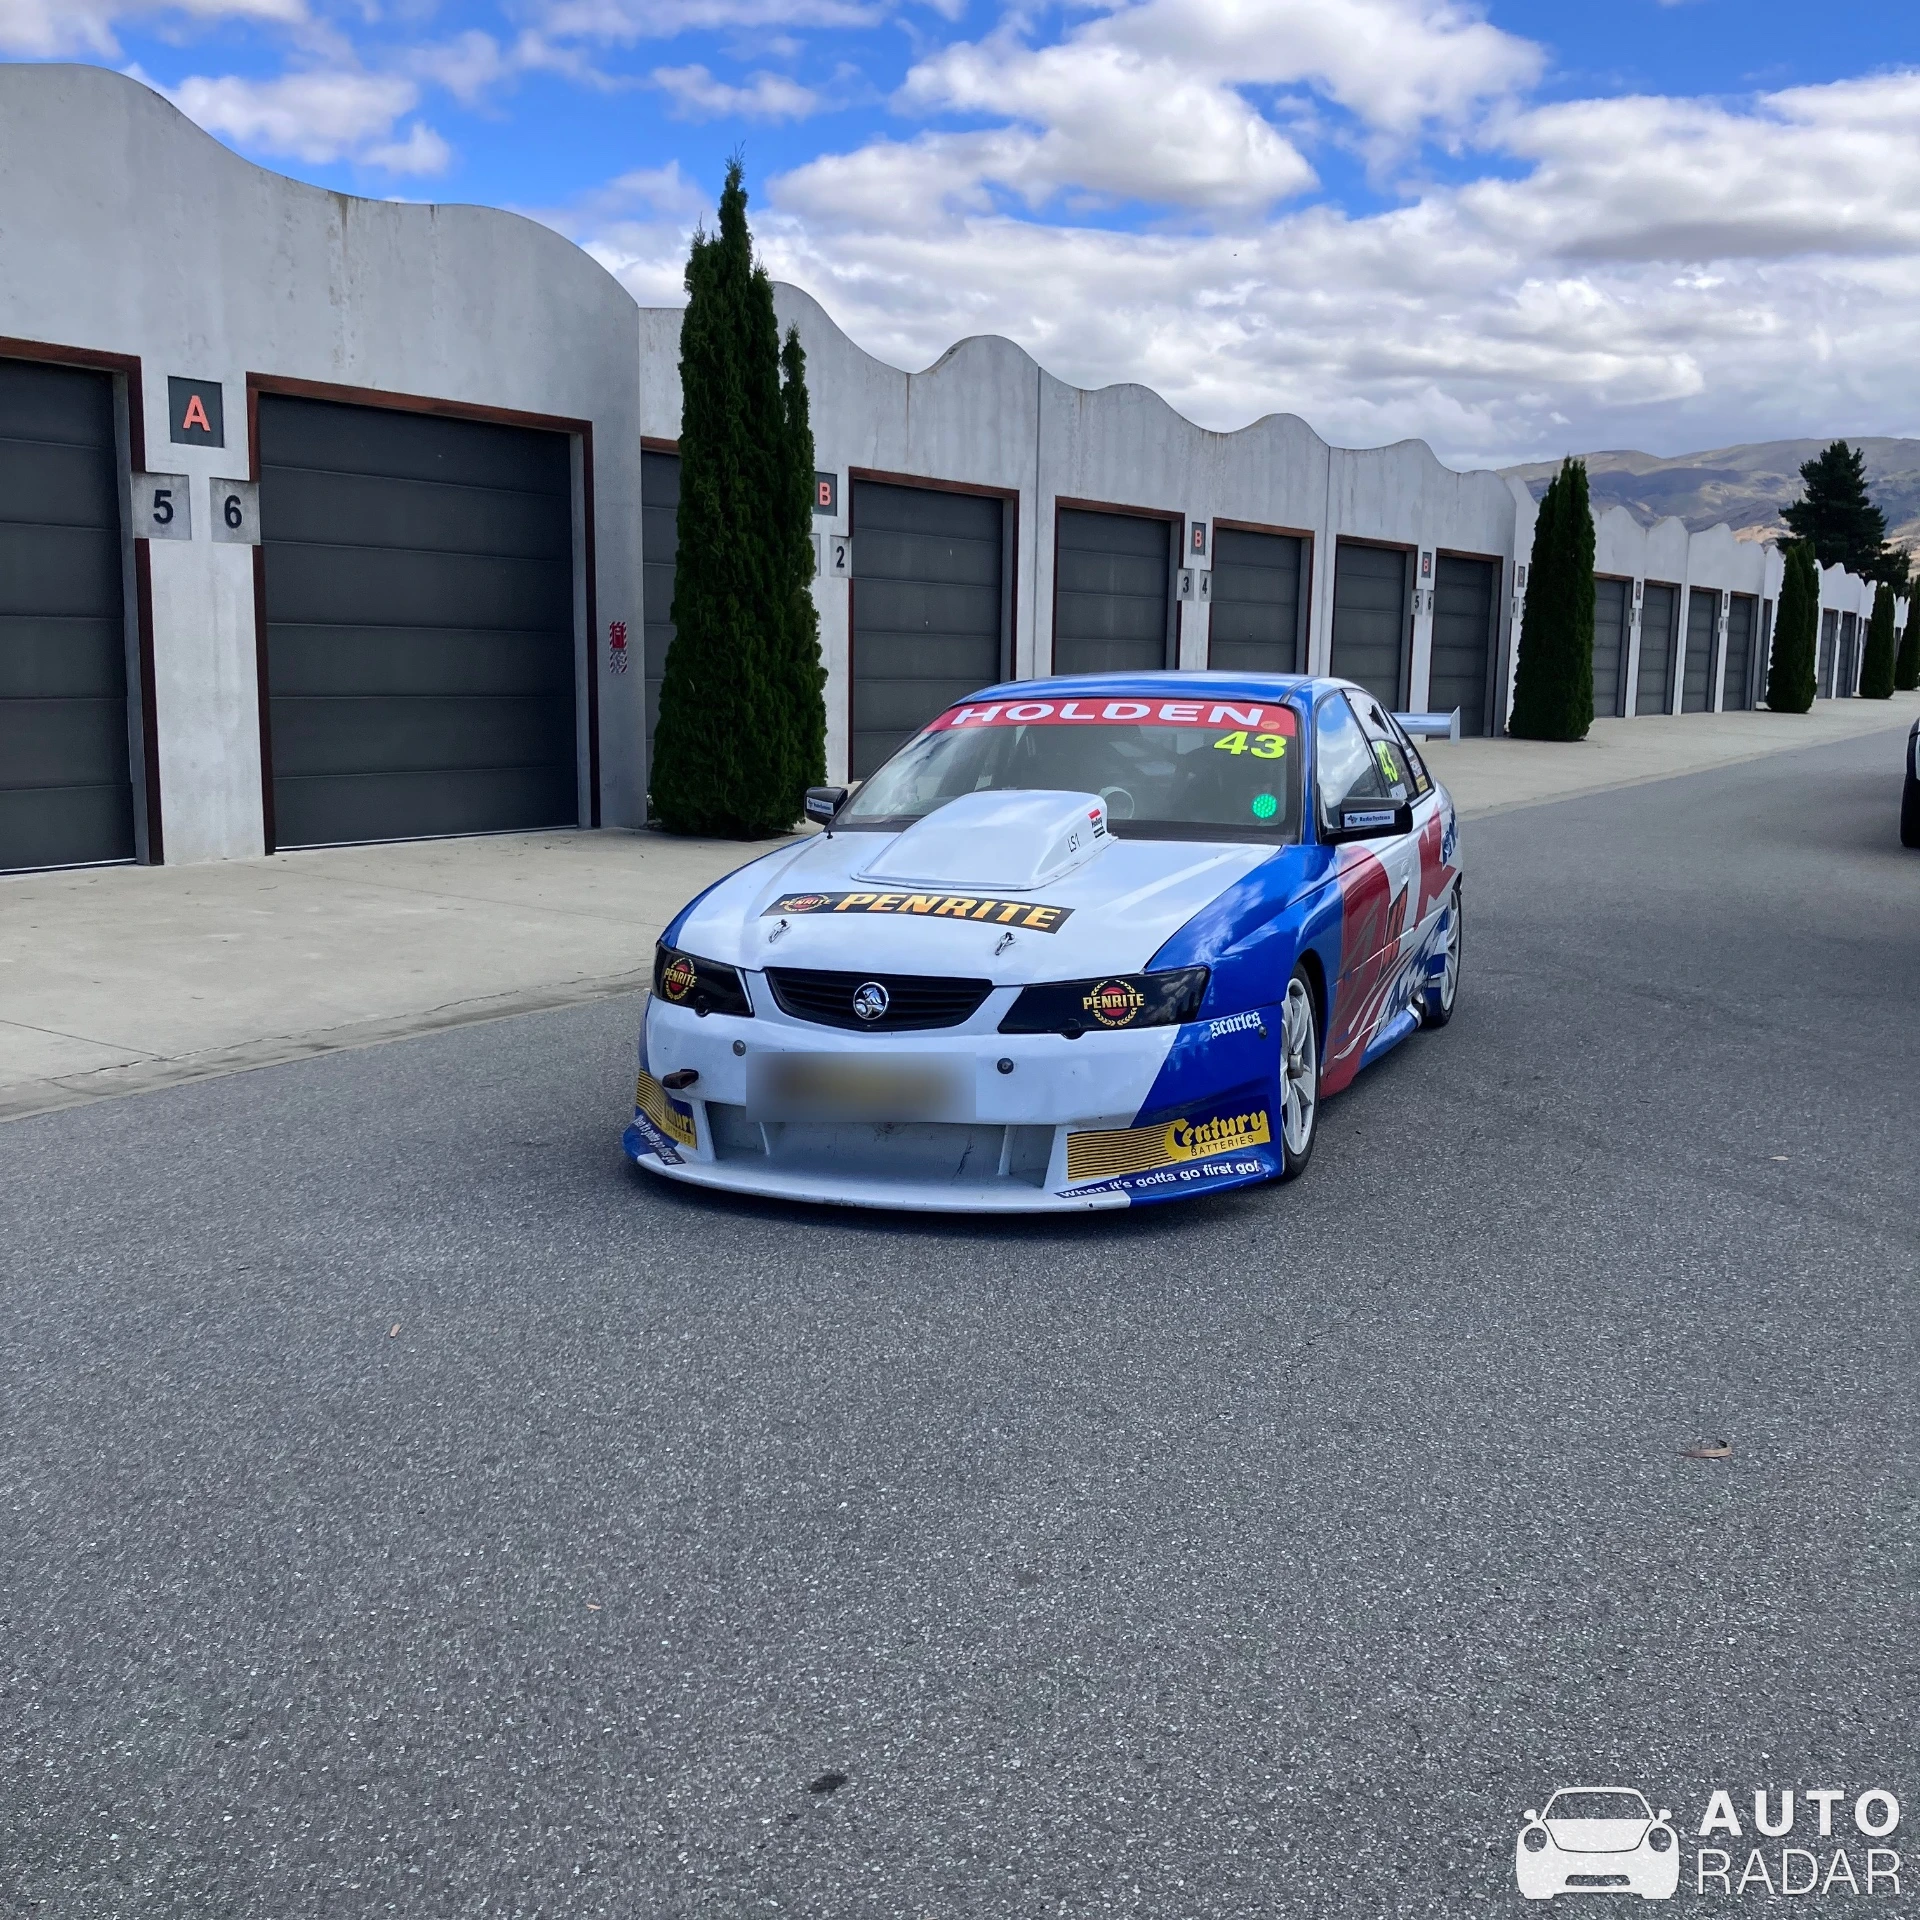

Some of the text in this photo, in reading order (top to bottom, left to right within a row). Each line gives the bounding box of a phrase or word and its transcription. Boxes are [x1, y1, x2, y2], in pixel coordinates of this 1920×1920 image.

[183, 394, 211, 432] A
[818, 482, 832, 506] B
[153, 489, 174, 525] 5
[224, 494, 243, 529] 6
[1194, 529, 1203, 548] B
[836, 545, 845, 569] 2
[1182, 576, 1190, 594] 3
[1201, 577, 1208, 595] 4
[1414, 595, 1420, 610] 5
[950, 702, 1263, 727] HOLDEN
[1213, 730, 1287, 759] 43
[1067, 832, 1080, 853] LS1
[833, 893, 1062, 929] PENRITE
[664, 967, 698, 988] PENRITE
[1082, 992, 1145, 1010] PENRITE
[1164, 1109, 1269, 1150] Century
[1190, 1134, 1254, 1157] BATTERIES
[1059, 1159, 1260, 1198] When it's gotta go first go!
